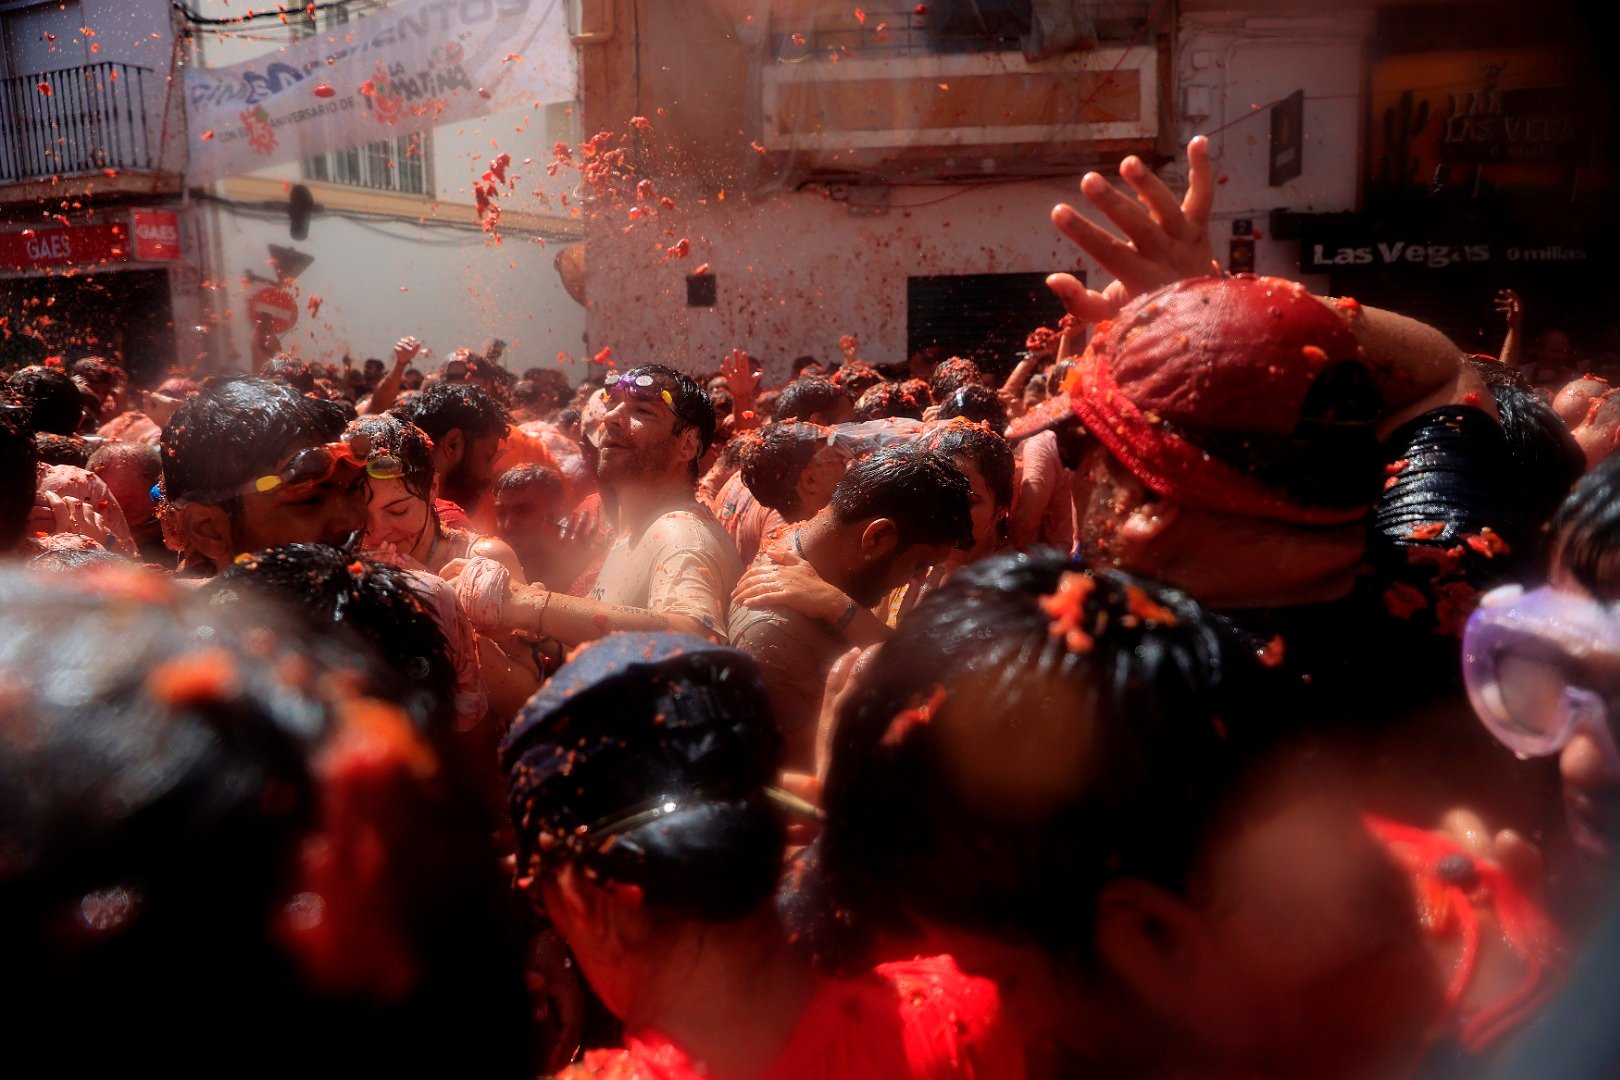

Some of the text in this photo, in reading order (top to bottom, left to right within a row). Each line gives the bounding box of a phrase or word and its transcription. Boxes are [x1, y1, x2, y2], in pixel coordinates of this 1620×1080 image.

[388, 60, 405, 77] LA
[218, 130, 238, 144] CON
[270, 101, 337, 128] ANIVERSARIO
[340, 96, 355, 111] DE
[138, 224, 177, 240] GAES
[27, 235, 72, 259] GAES
[1313, 244, 1374, 265] Las
[1523, 245, 1587, 261] millas
